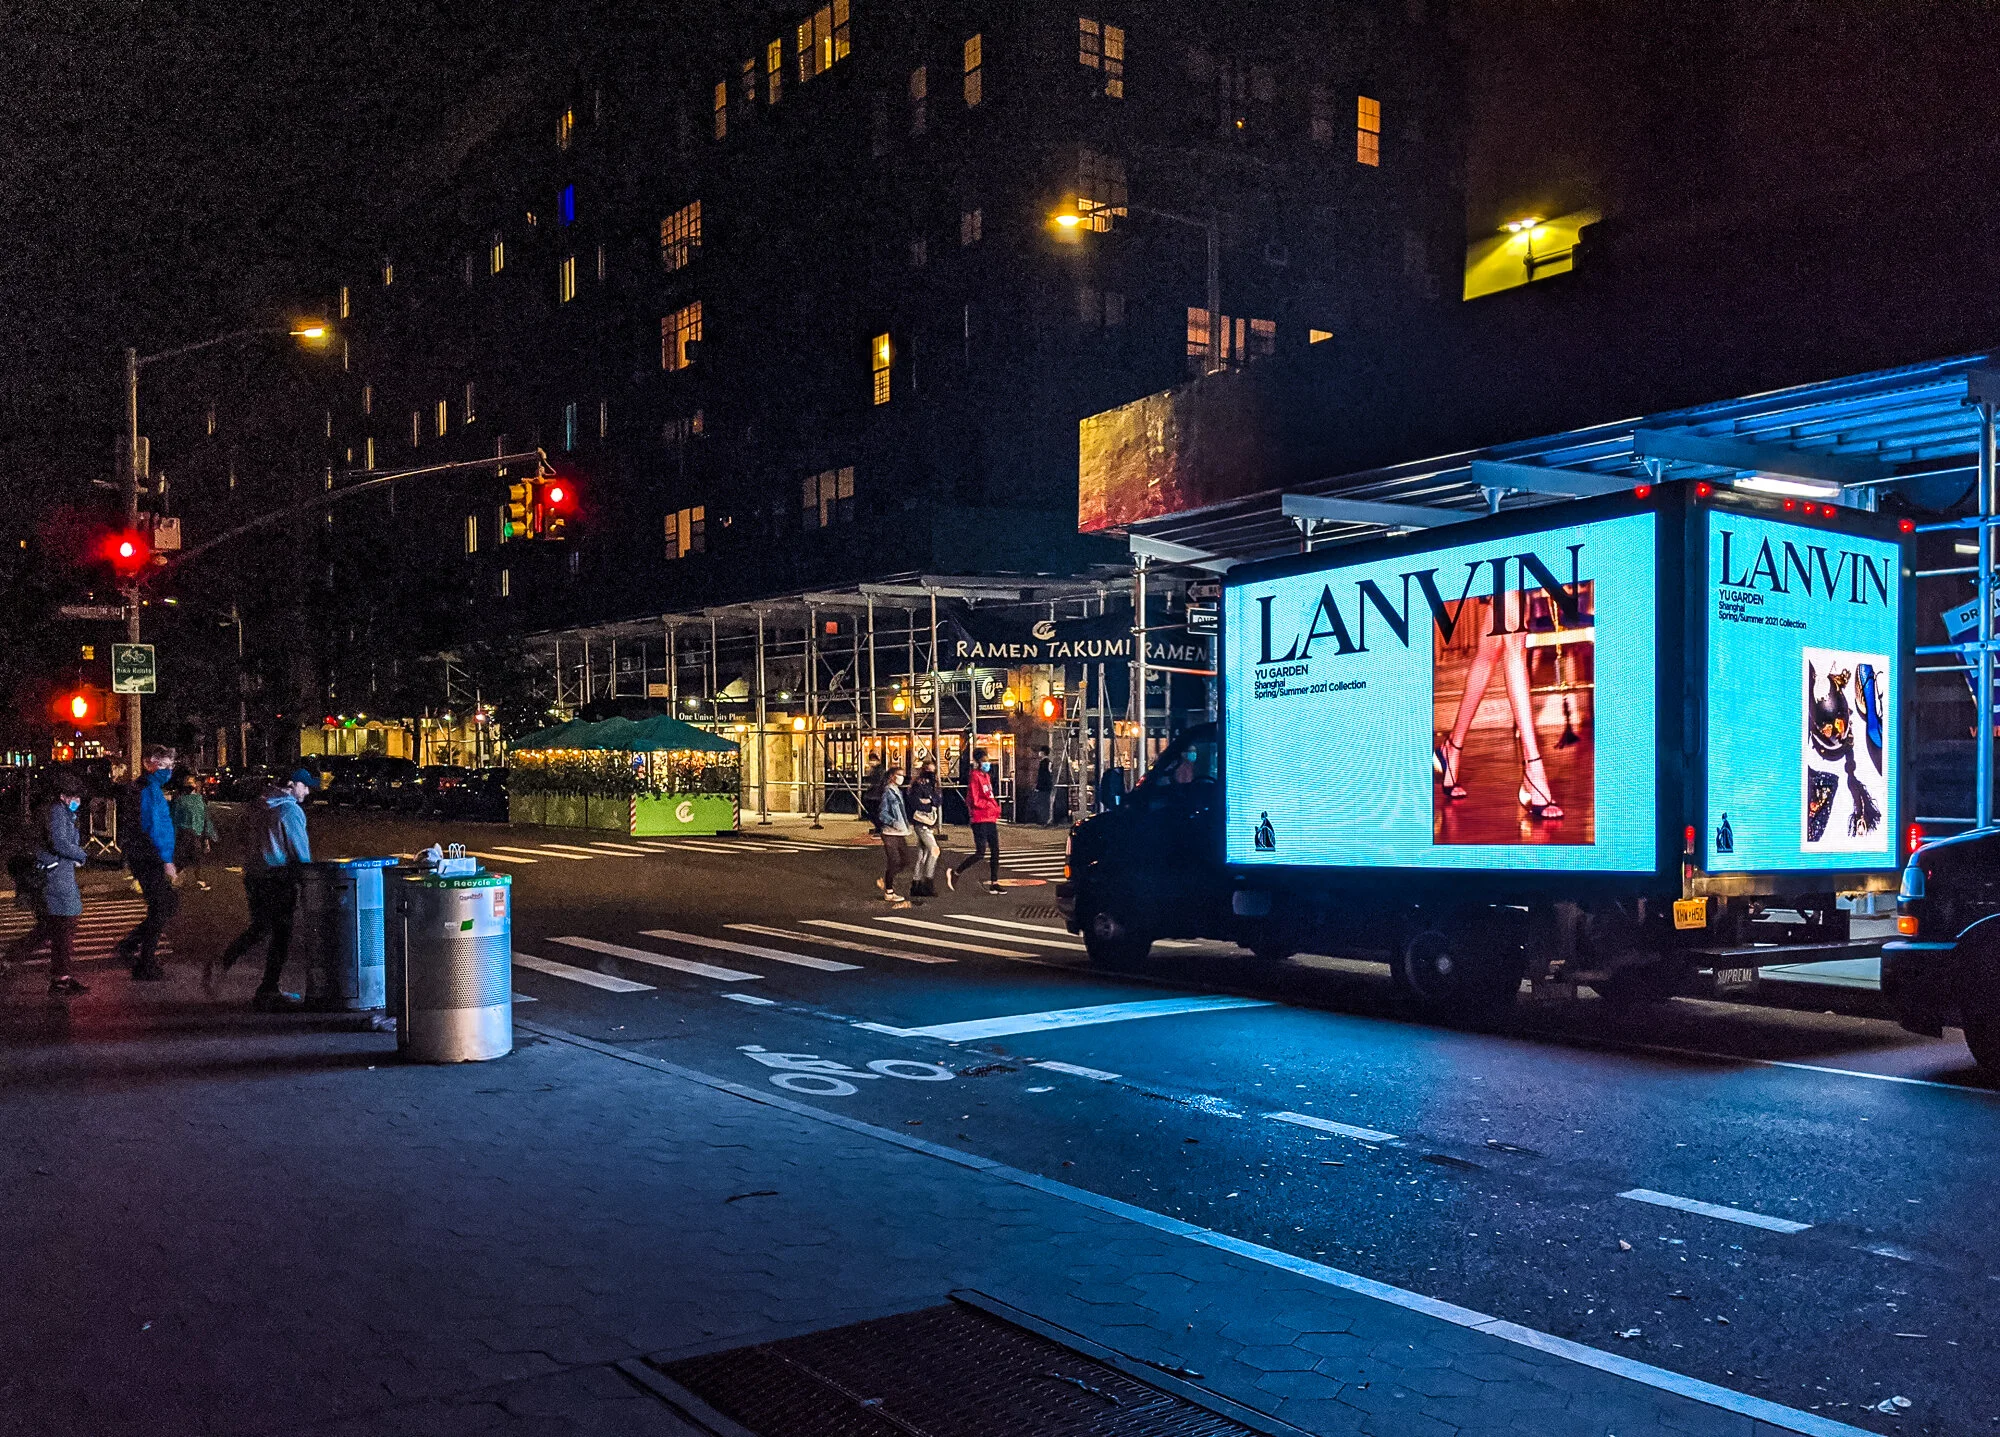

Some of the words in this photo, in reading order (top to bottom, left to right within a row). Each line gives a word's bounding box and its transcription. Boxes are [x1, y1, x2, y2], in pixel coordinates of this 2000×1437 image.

[1719, 530, 1890, 608] LANVIN
[1256, 544, 1585, 665] LANVIN
[1719, 589, 1731, 601] YU
[1731, 591, 1764, 605] GARDEN
[1719, 601, 1746, 612] Shanghai
[1719, 611, 1764, 623] Spring/Summer
[1765, 615, 1779, 626] 2021
[1779, 617, 1807, 629] Collection
[956, 640, 1038, 659] RAMEN
[1045, 638, 1131, 658] TAKUMI
[1254, 668, 1268, 680] YU
[1269, 664, 1309, 678] GARDEN
[1254, 678, 1286, 691] Shanghai
[1254, 686, 1309, 700] Spring/Summer
[1310, 682, 1328, 694] 2021
[1328, 680, 1367, 692] Collection
[678, 712, 693, 721] One
[694, 712, 728, 723] Univesity
[728, 712, 747, 721] Place
[454, 879, 491, 888] Recycle
